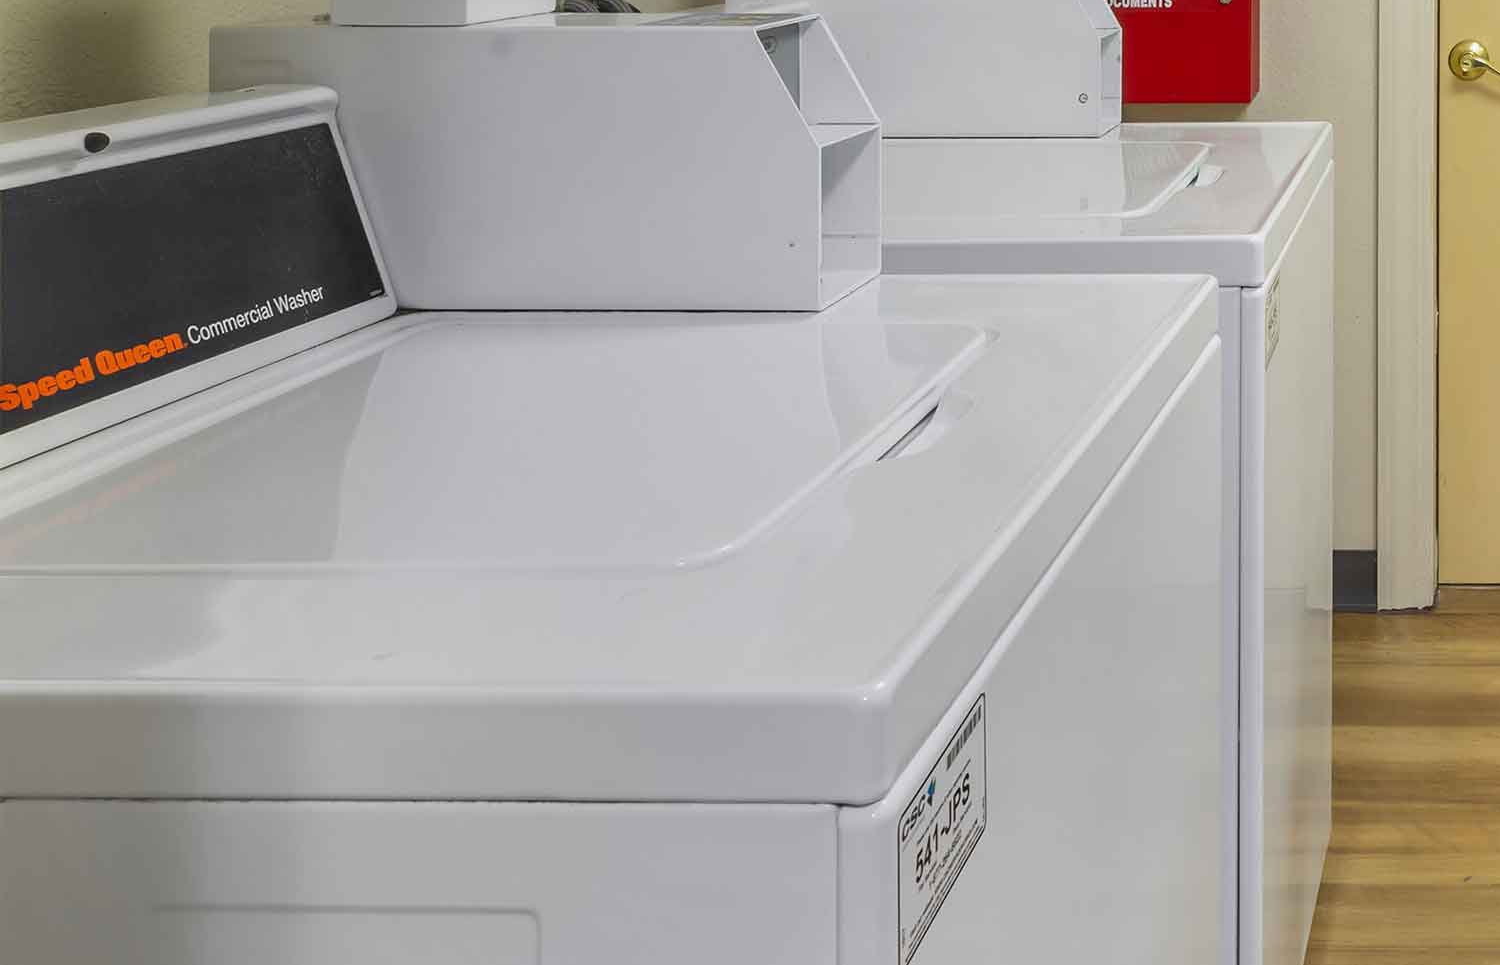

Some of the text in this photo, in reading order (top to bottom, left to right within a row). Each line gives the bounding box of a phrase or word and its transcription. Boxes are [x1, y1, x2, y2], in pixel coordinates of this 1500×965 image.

[0, 286, 324, 411] Speed Queen Commercial Washer
[901, 794, 926, 842] CSC
[915, 773, 970, 884] 541-JPS
